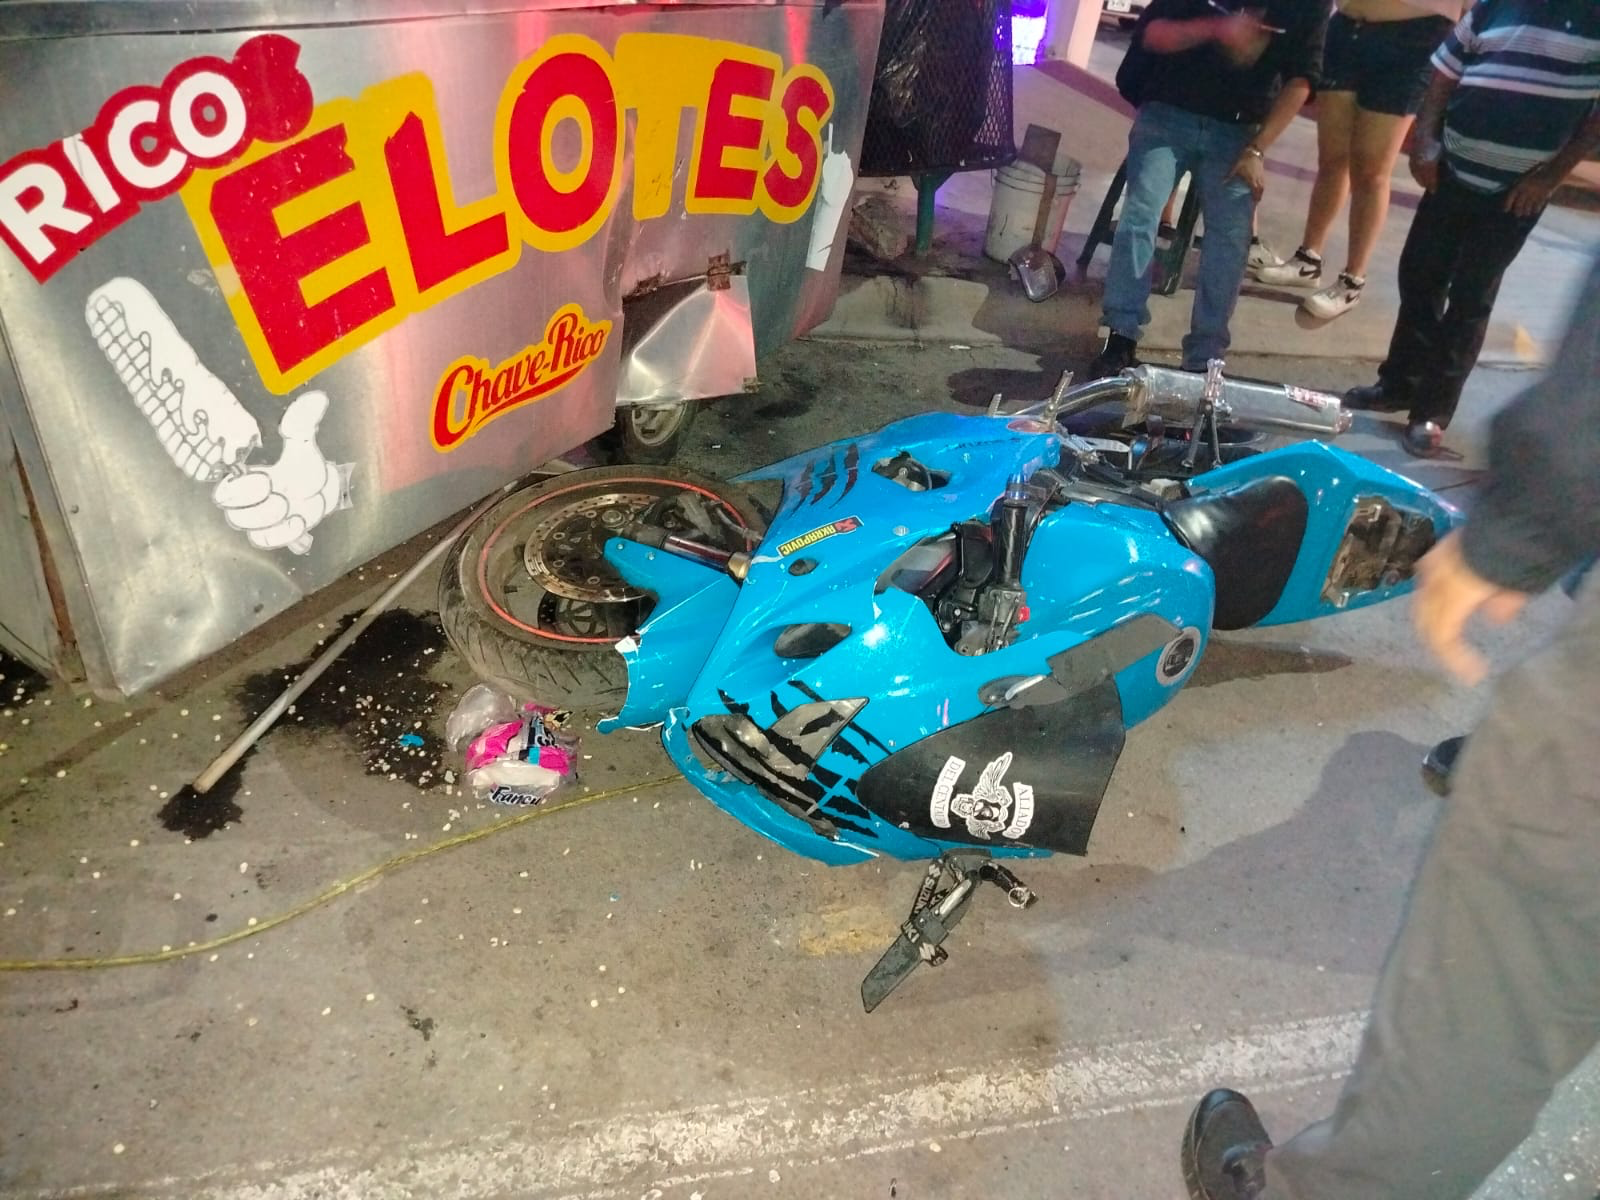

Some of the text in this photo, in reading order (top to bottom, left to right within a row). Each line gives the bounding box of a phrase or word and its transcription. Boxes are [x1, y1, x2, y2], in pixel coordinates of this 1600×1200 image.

[205, 36, 831, 377] ELOTES
[434, 313, 606, 445] Chave-Rico
[780, 524, 837, 556] AKRAPOVIC
